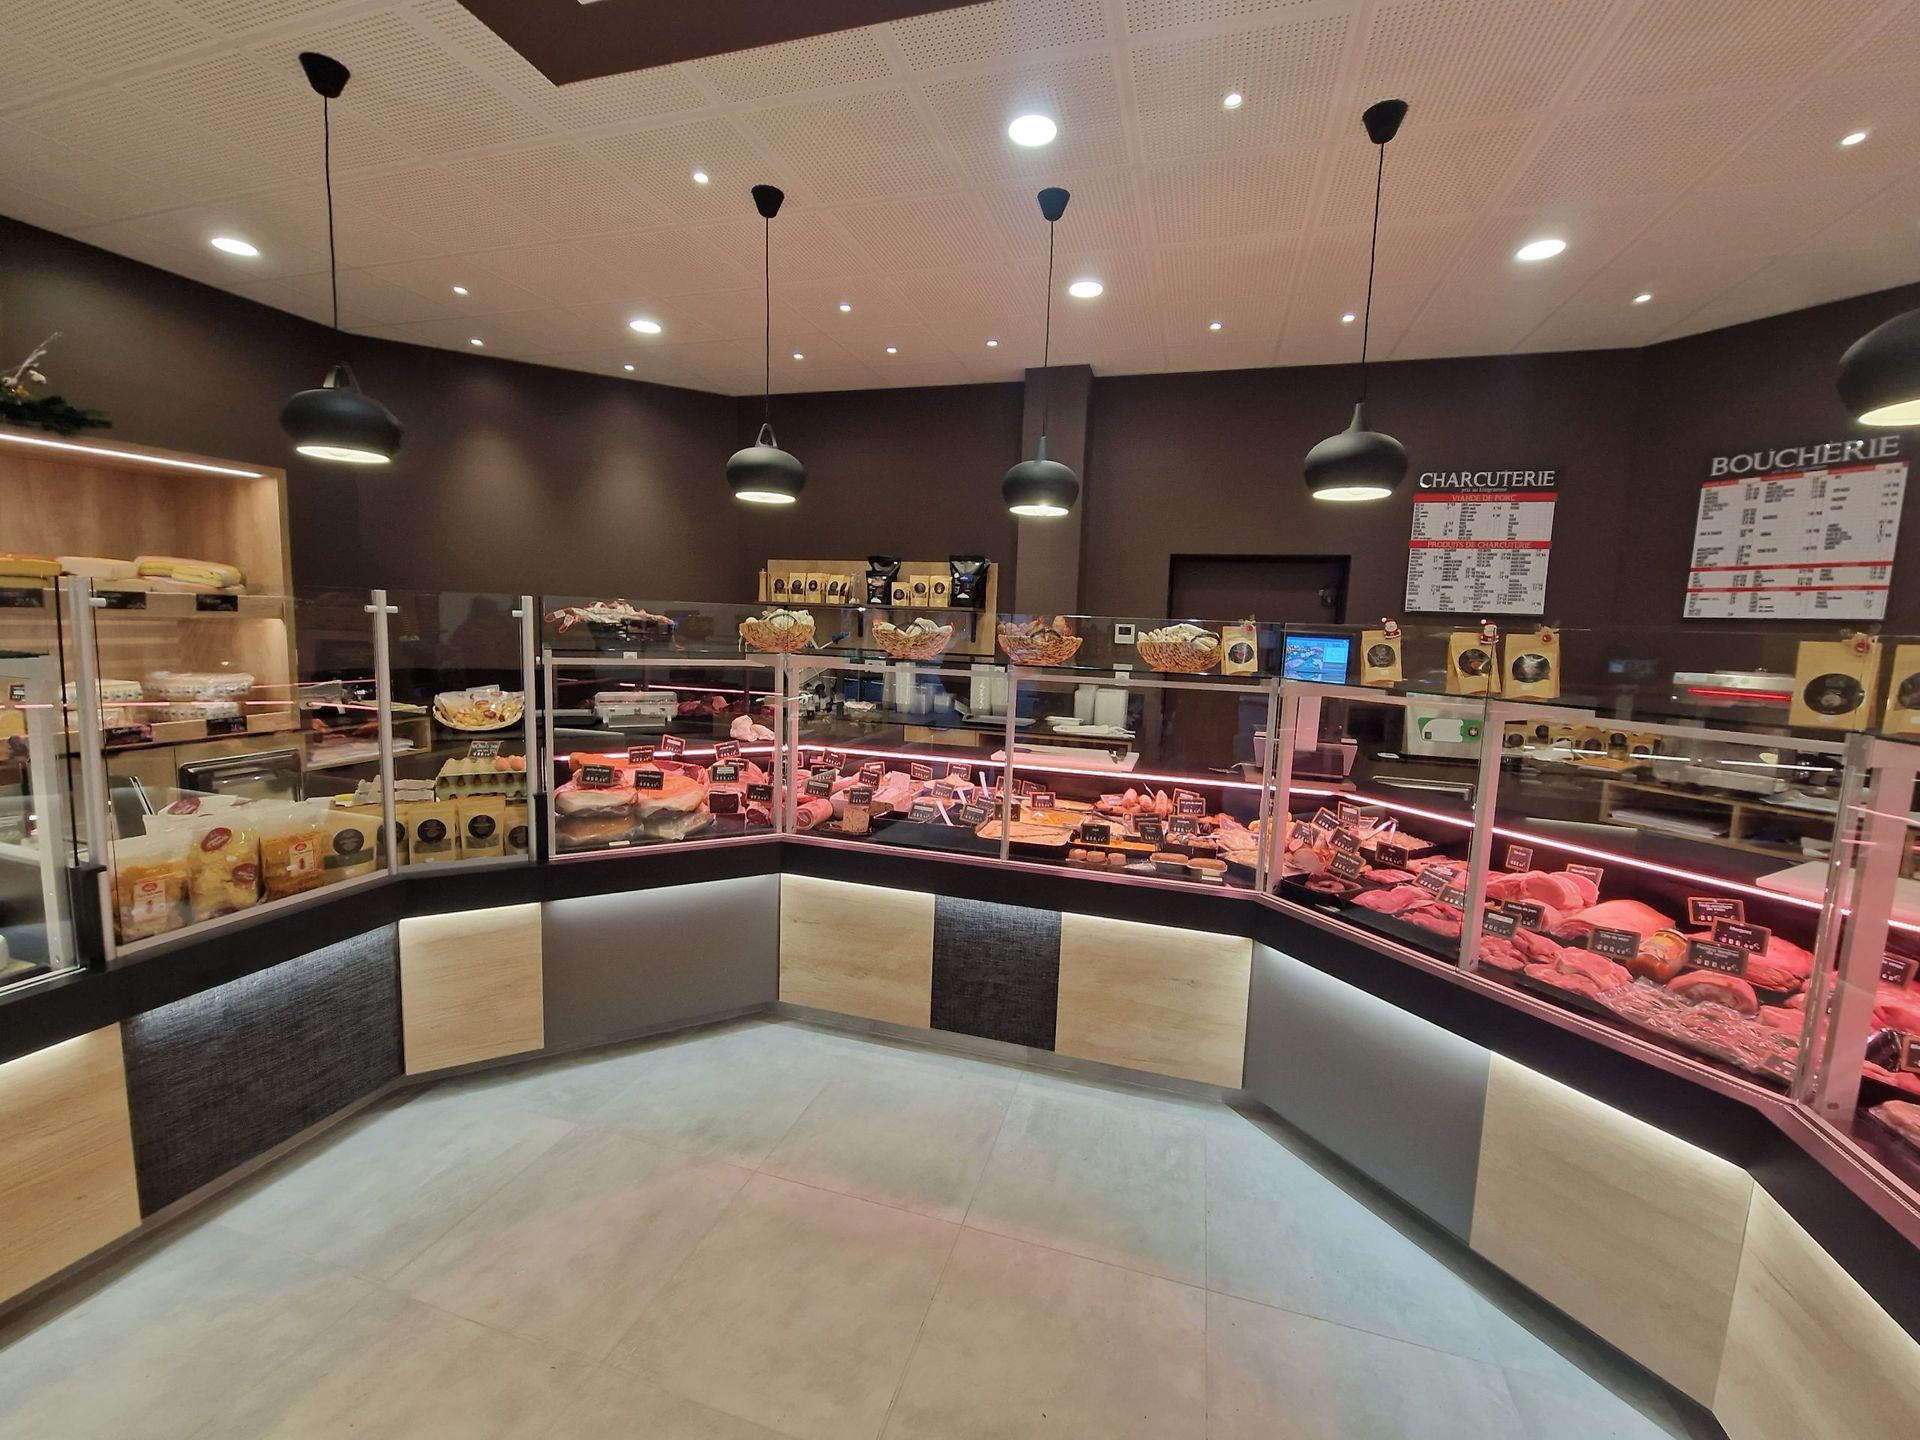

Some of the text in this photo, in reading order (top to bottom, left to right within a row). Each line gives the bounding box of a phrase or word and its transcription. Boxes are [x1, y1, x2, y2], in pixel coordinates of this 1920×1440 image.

[1710, 436, 1900, 477] BOUCHERIE
[1419, 470, 1555, 488] CHARCUTERIE
[1452, 494, 1483, 502] VIANDE
[1427, 541, 1464, 549] PRODUITS
